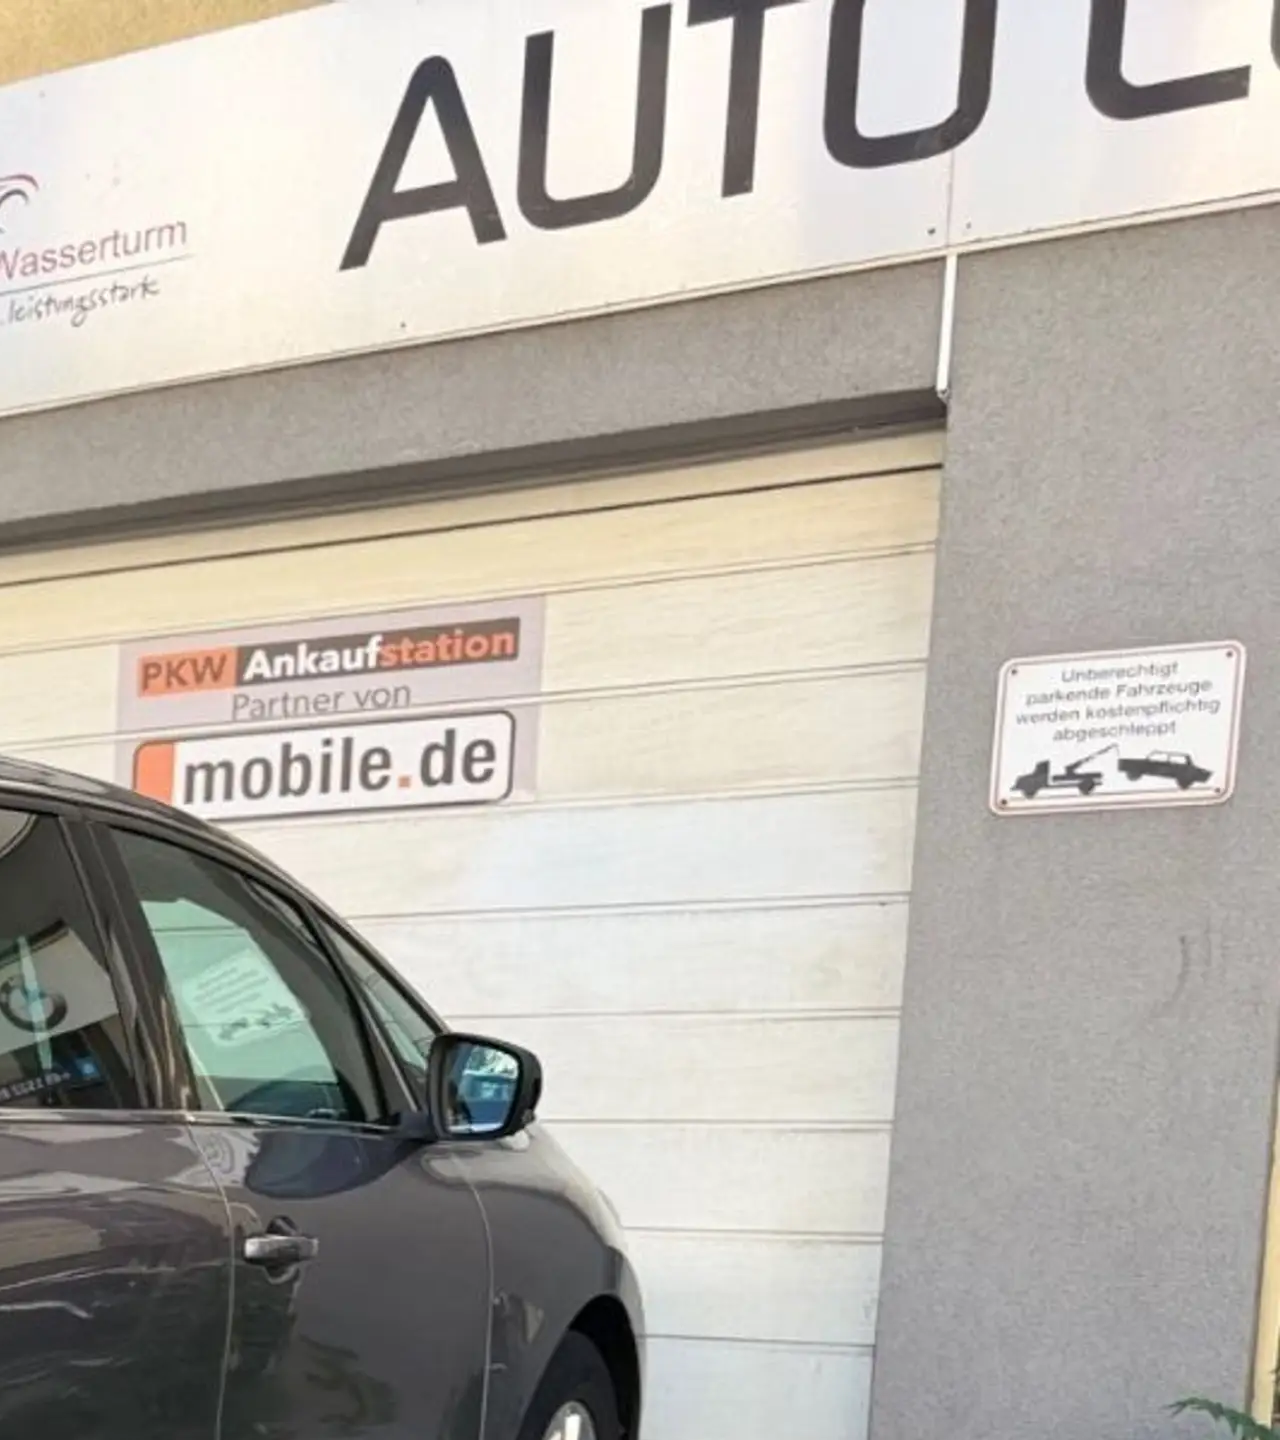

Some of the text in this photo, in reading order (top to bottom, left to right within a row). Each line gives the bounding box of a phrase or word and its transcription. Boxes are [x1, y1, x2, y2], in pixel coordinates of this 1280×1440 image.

[339, 0, 999, 271] AUTO
[142, 627, 516, 691] PKW Ankaufstation
[1061, 661, 1179, 683] Unberechtigt
[230, 684, 412, 722] Partner von
[1025, 679, 1214, 706] parkende Fahrzeuge
[1016, 698, 1221, 725] werden kostenpflichtig
[1052, 720, 1177, 743] abgeschleppt
[183, 728, 498, 804] mobile.de
